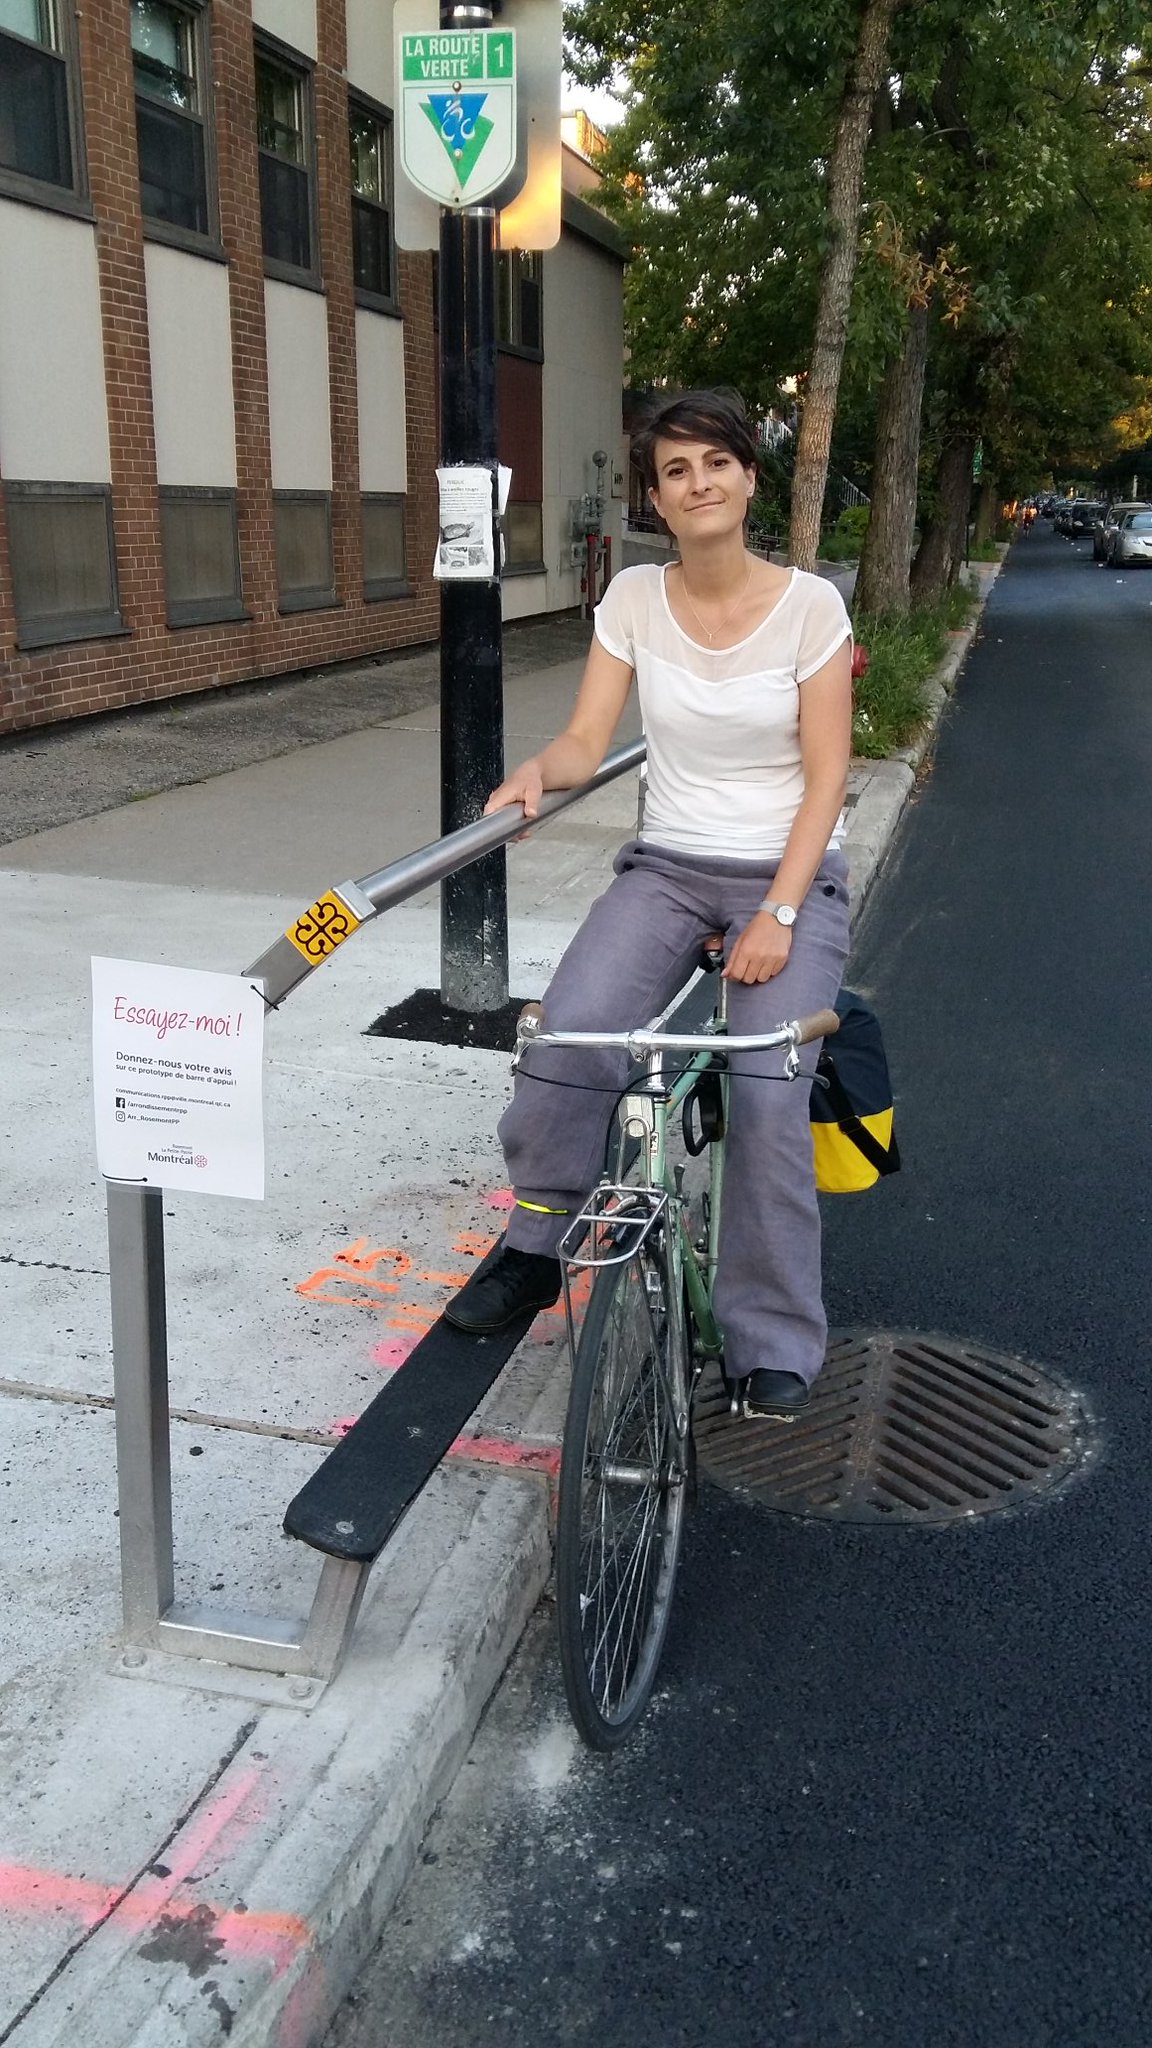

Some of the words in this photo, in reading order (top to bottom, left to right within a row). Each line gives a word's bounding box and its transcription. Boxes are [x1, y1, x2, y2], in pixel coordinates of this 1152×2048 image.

[405, 40, 424, 57] LA
[429, 37, 480, 55] ROUTE
[494, 43, 505, 68] 1
[421, 59, 469, 77] VERTE
[116, 1051, 182, 1069] Donnez-nous
[184, 1063, 211, 1073] votre
[213, 1066, 232, 1077] avis
[138, 1067, 173, 1078] prototype
[174, 1072, 184, 1080] de
[186, 1073, 205, 1082] barre
[148, 1152, 194, 1166] Montréal
